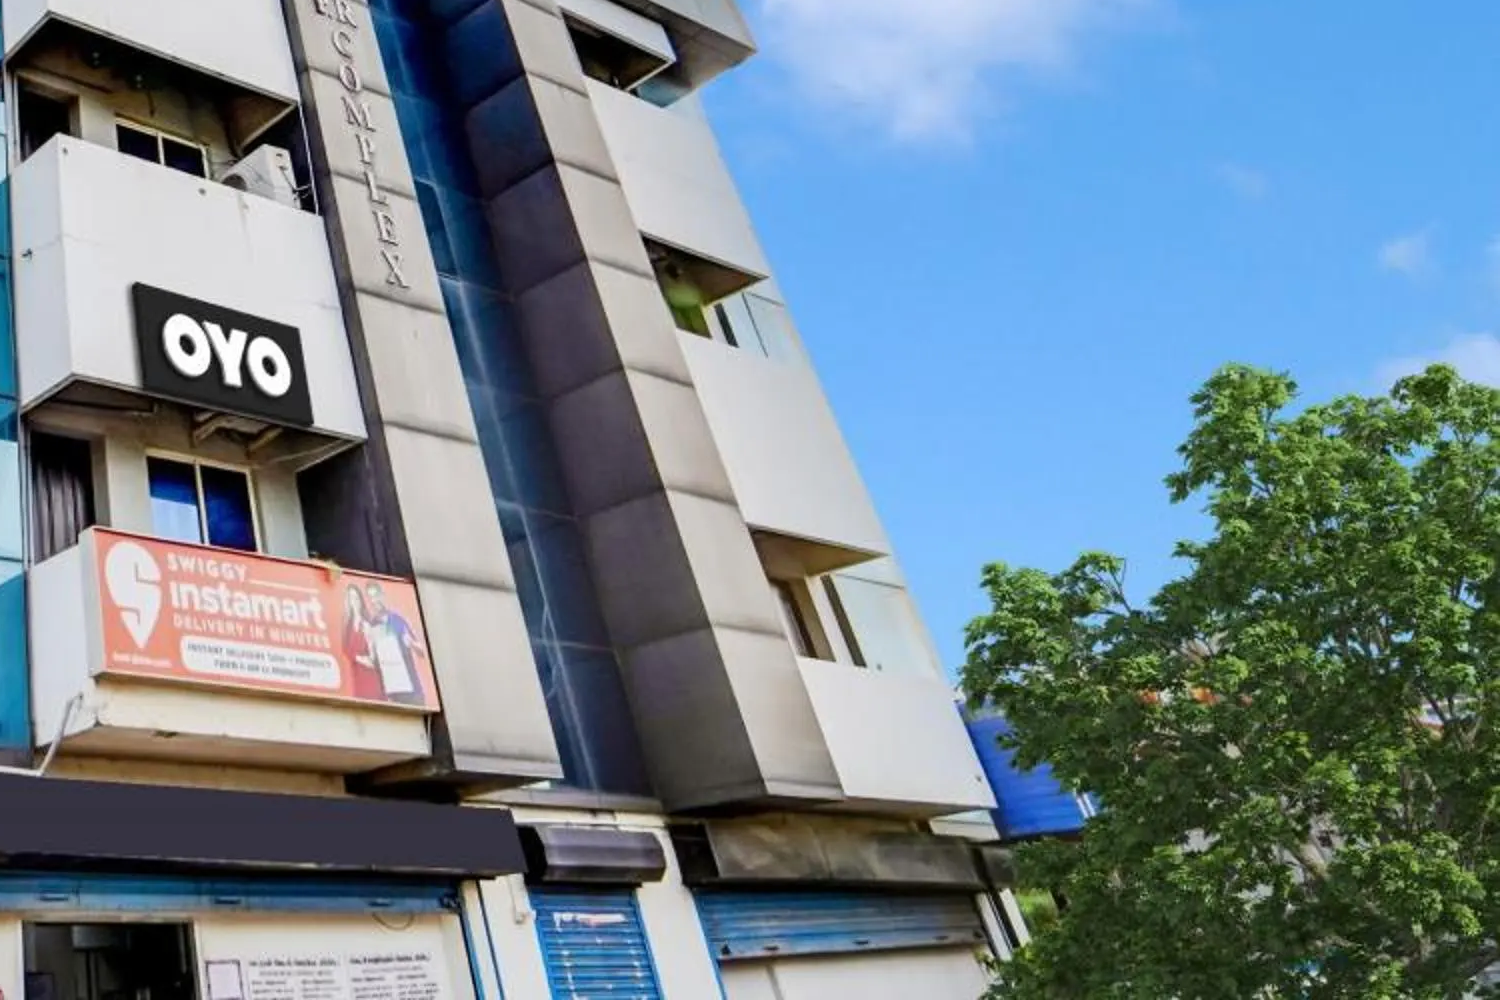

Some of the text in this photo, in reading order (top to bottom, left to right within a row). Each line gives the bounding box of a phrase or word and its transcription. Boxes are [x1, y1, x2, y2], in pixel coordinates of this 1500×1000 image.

[331, 30, 409, 289] COMPLEX
[162, 313, 292, 397] OYO
[167, 552, 247, 582] SWIGGY
[169, 580, 327, 630] instamart
[173, 613, 330, 649] DELIVERY IN MINUTES
